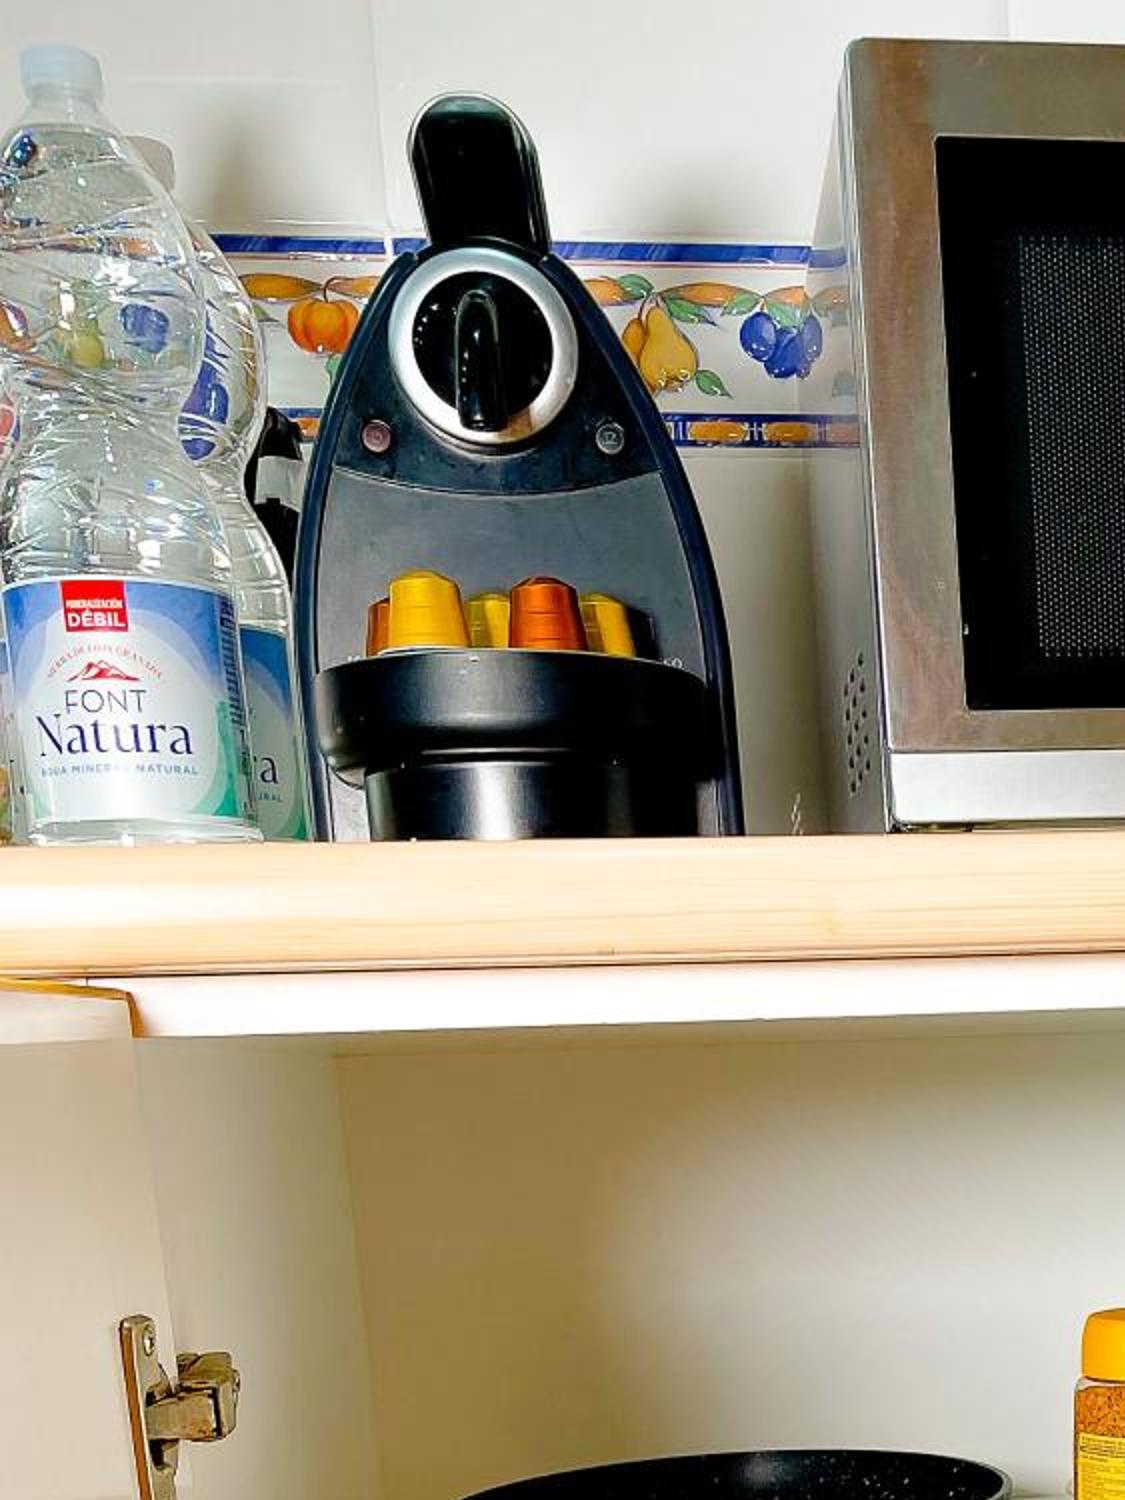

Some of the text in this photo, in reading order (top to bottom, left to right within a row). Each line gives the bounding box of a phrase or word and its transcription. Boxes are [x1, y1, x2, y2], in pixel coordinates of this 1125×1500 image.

[67, 608, 126, 627] DÉBIL
[65, 688, 147, 714] FONT
[36, 712, 194, 757] Natura
